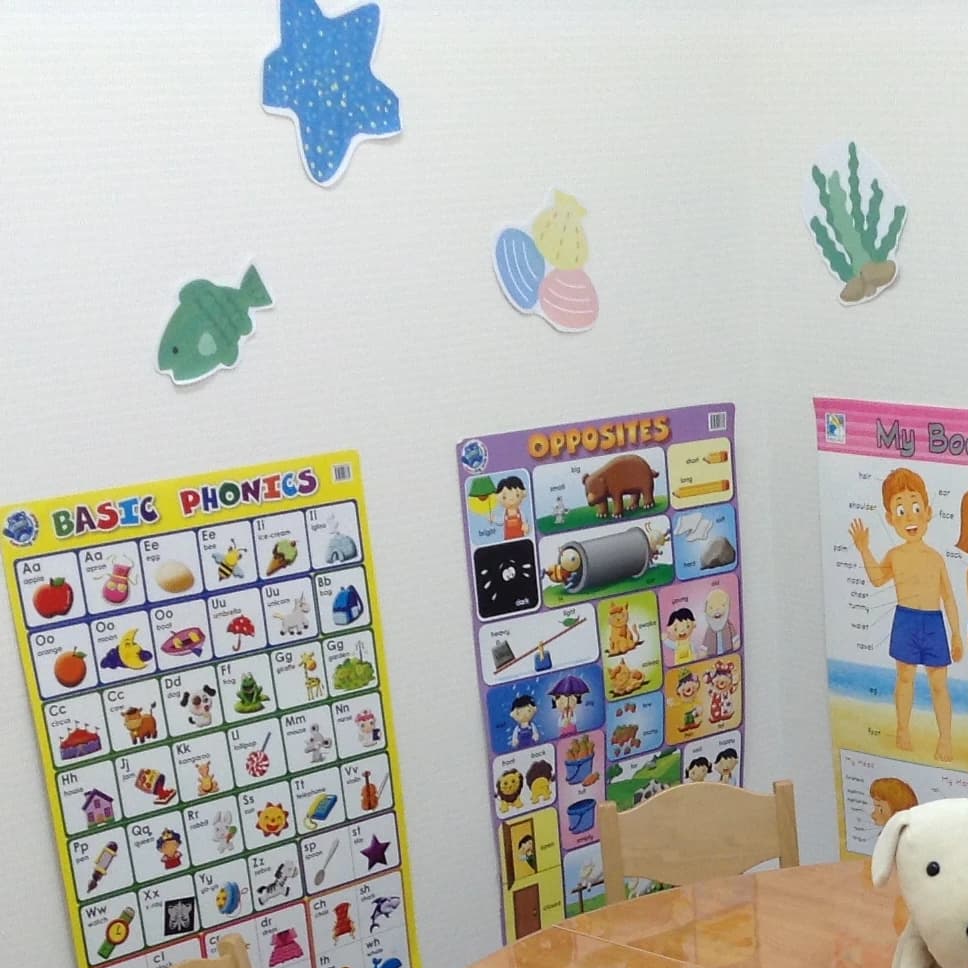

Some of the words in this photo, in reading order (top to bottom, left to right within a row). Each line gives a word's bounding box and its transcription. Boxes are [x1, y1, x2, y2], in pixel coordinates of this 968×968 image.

[527, 415, 672, 459] OPPOSITES
[875, 417, 916, 458] My
[52, 496, 160, 538] BASIC
[179, 468, 318, 516] PHONICS
[202, 530, 216, 540] Ee
[144, 541, 160, 551] Ee
[84, 551, 103, 563] Aa
[22, 562, 41, 574] Aa
[317, 577, 331, 587] Bb
[265, 587, 280, 598] Uu
[211, 599, 226, 609] Uu
[154, 609, 173, 621] Oo
[95, 621, 115, 633] Oo
[35, 635, 55, 647] Oo
[327, 640, 344, 651] Gg
[275, 652, 293, 663] Gg
[221, 664, 231, 675] Ff
[165, 677, 181, 689] Dd
[107, 691, 125, 702] Cc
[49, 705, 67, 717] Cc
[335, 703, 349, 714] Nn
[285, 715, 306, 727] Mm
[176, 744, 191, 755] Kk
[62, 773, 78, 786] Hh
[295, 781, 304, 791] Tt
[187, 811, 199, 820] Rr
[132, 825, 152, 837] Qq
[352, 827, 361, 836] st
[73, 842, 89, 852] Pp
[304, 842, 316, 853] sp
[199, 873, 213, 884] Yy
[359, 885, 370, 895] sh
[313, 900, 327, 910] ch
[85, 906, 107, 918] Ww
[261, 916, 272, 927] dr
[366, 937, 380, 949] wh
[153, 951, 165, 963] cl
[320, 956, 330, 966] th
